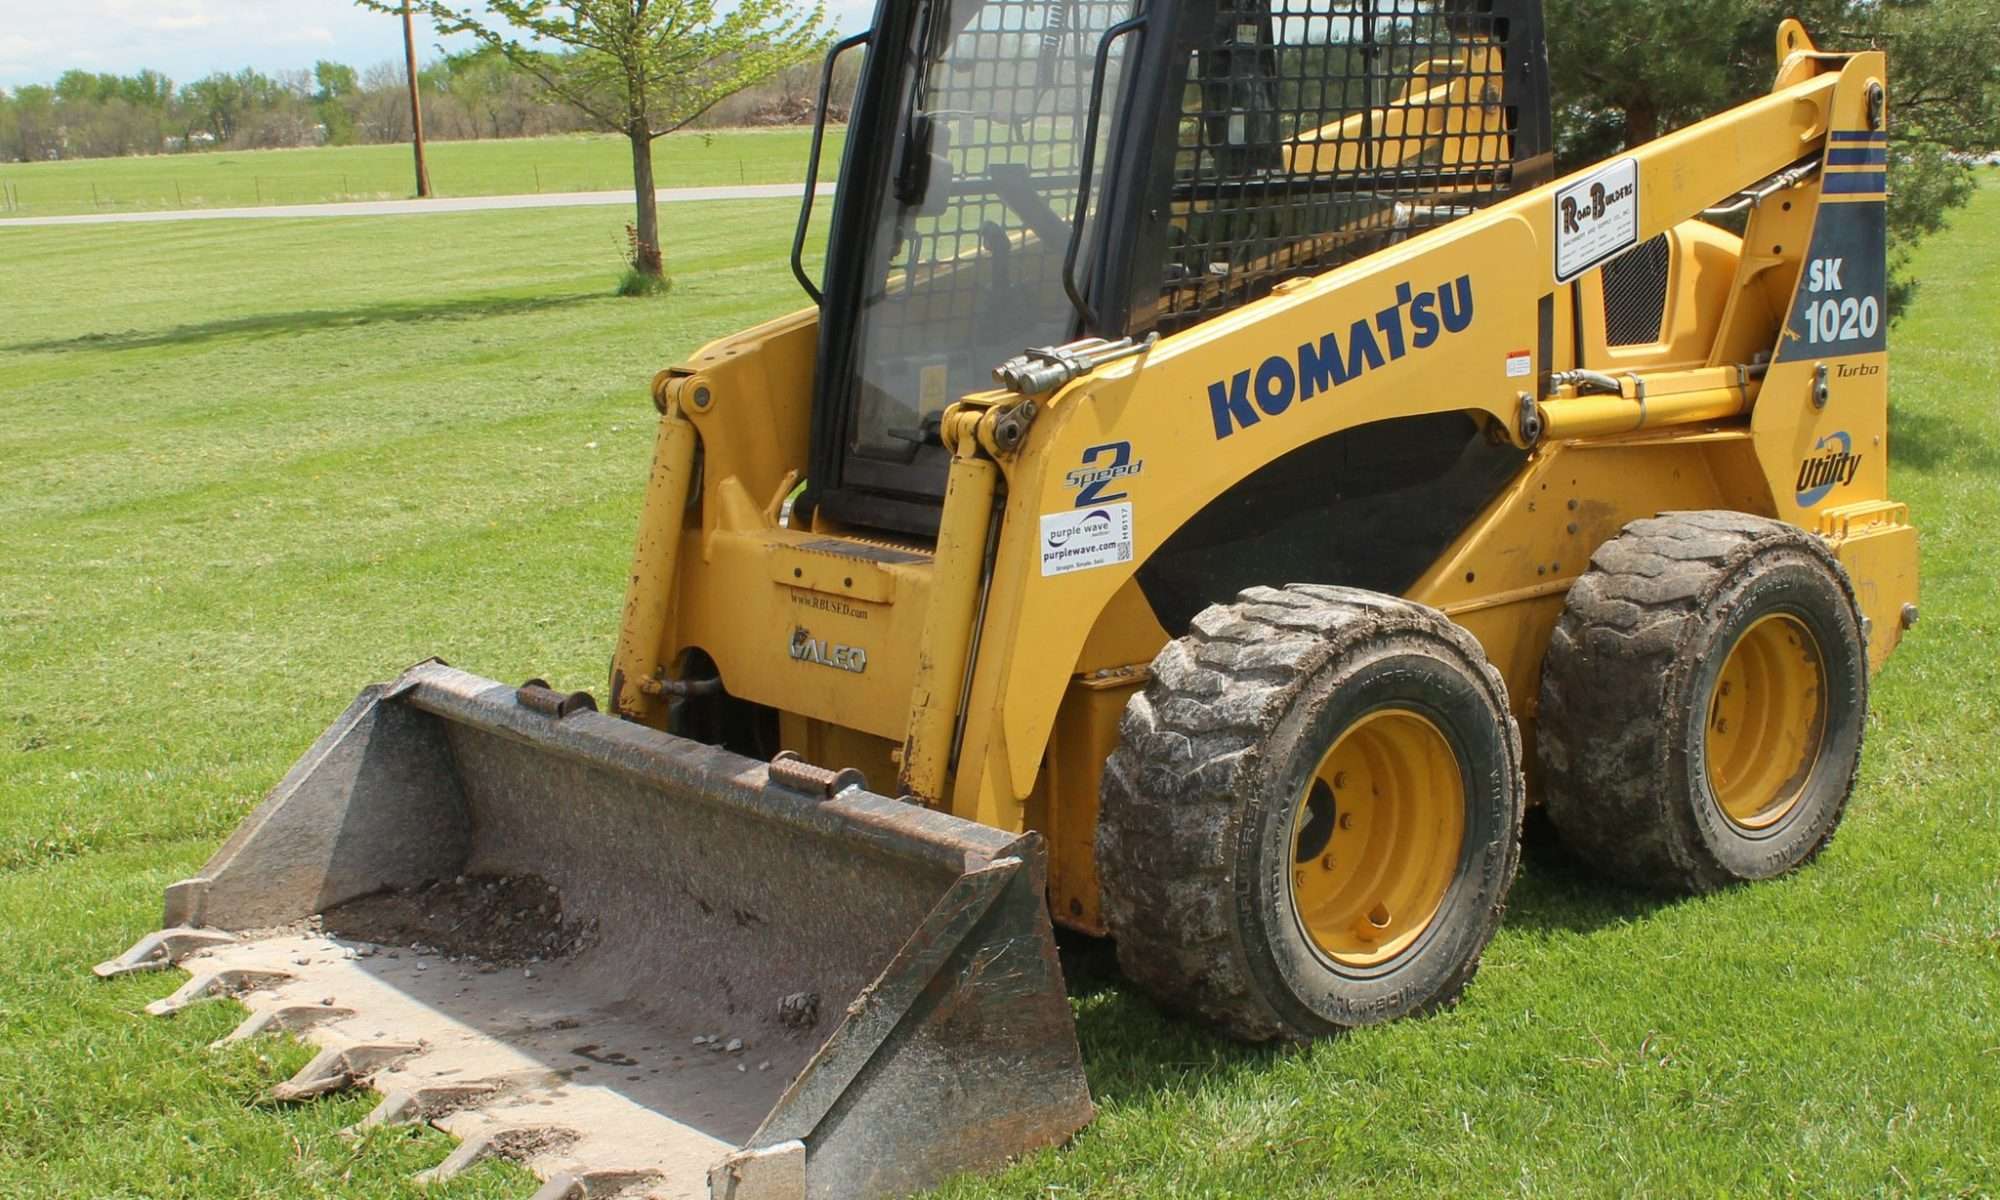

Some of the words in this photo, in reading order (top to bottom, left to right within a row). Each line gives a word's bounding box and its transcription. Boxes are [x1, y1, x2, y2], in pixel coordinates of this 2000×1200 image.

[1808, 258, 1842, 292] SK
[1805, 296, 1879, 343] 1020
[1207, 274, 1474, 441] KOMATSU
[1836, 364, 1879, 378] Turbo
[1066, 460, 1143, 487] Speed
[1075, 441, 1131, 508] 2
[1796, 451, 1862, 492] Utility
[1050, 525, 1081, 540] purple
[1084, 521, 1109, 533] wave
[1043, 541, 1117, 563] purplewave.com
